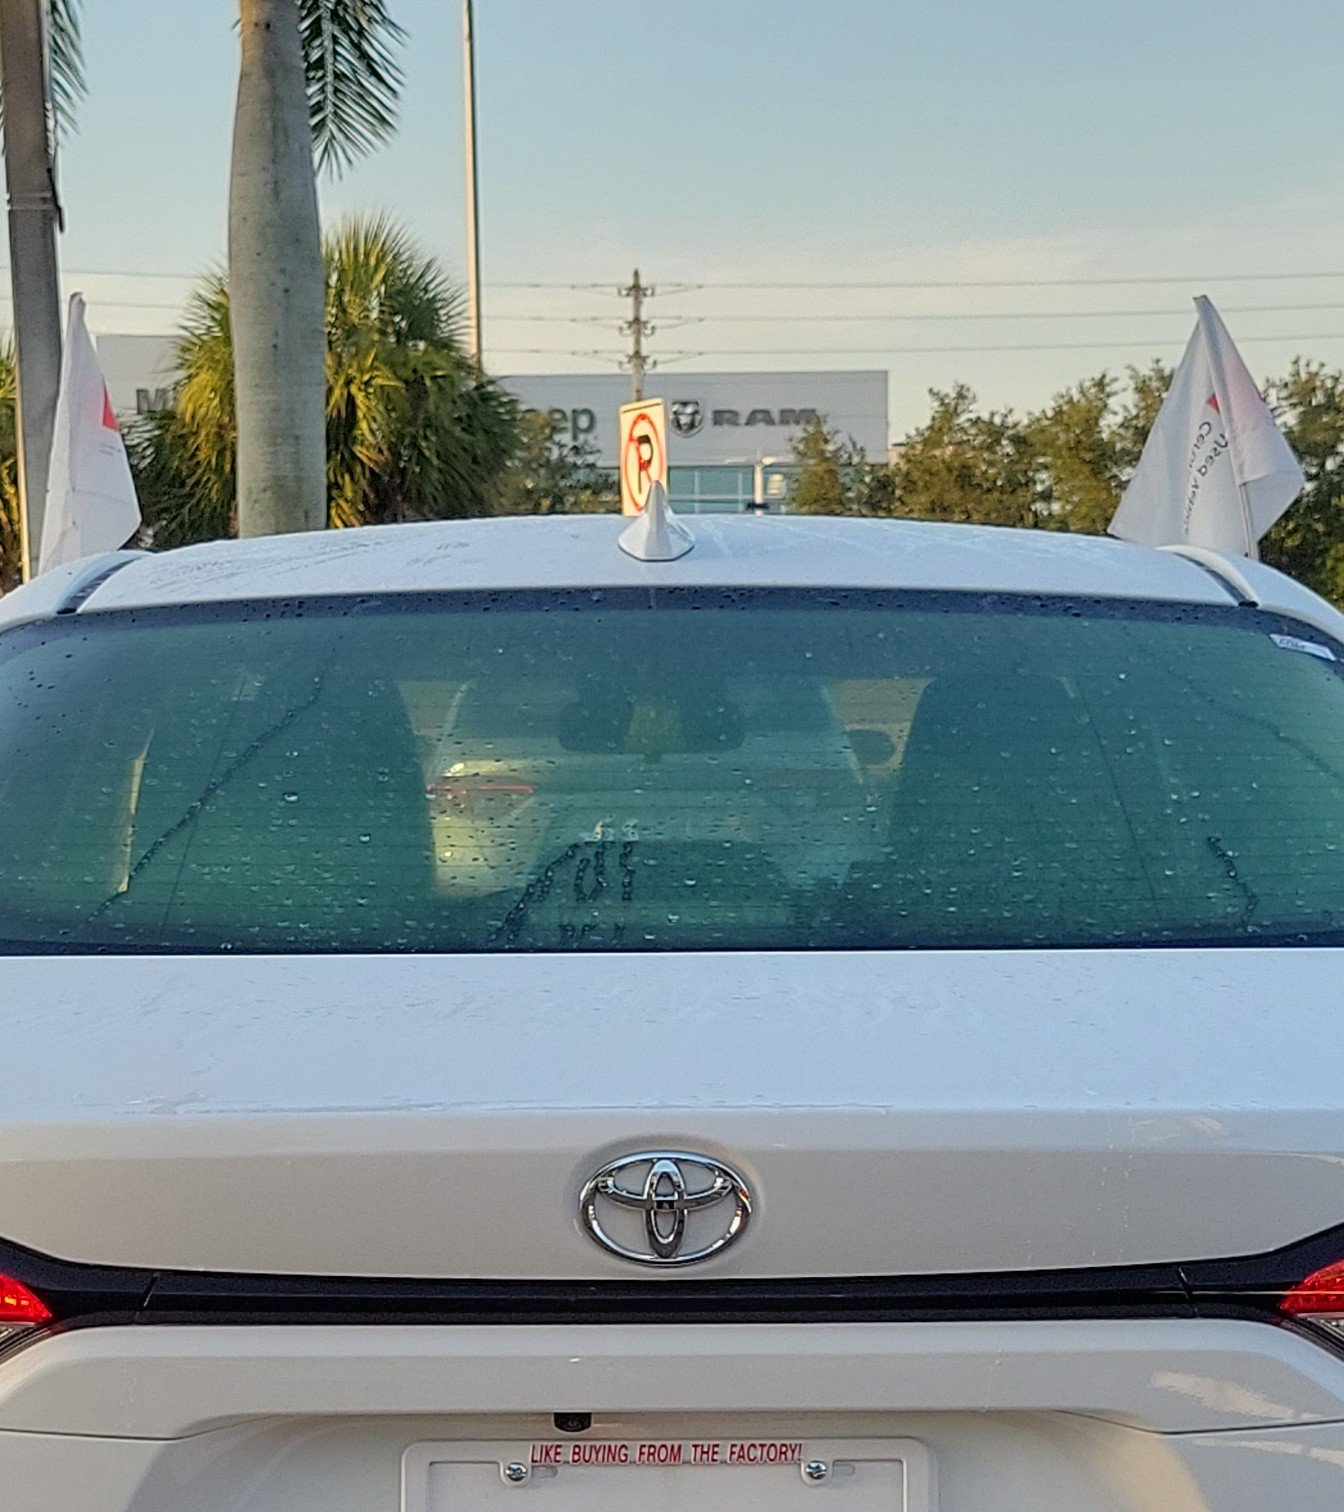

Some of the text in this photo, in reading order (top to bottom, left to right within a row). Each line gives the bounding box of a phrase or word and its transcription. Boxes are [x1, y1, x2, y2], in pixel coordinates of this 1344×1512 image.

[712, 407, 819, 427] RAM
[530, 1442, 803, 1464] LIKE BUYING FROM THE FACTORY!
